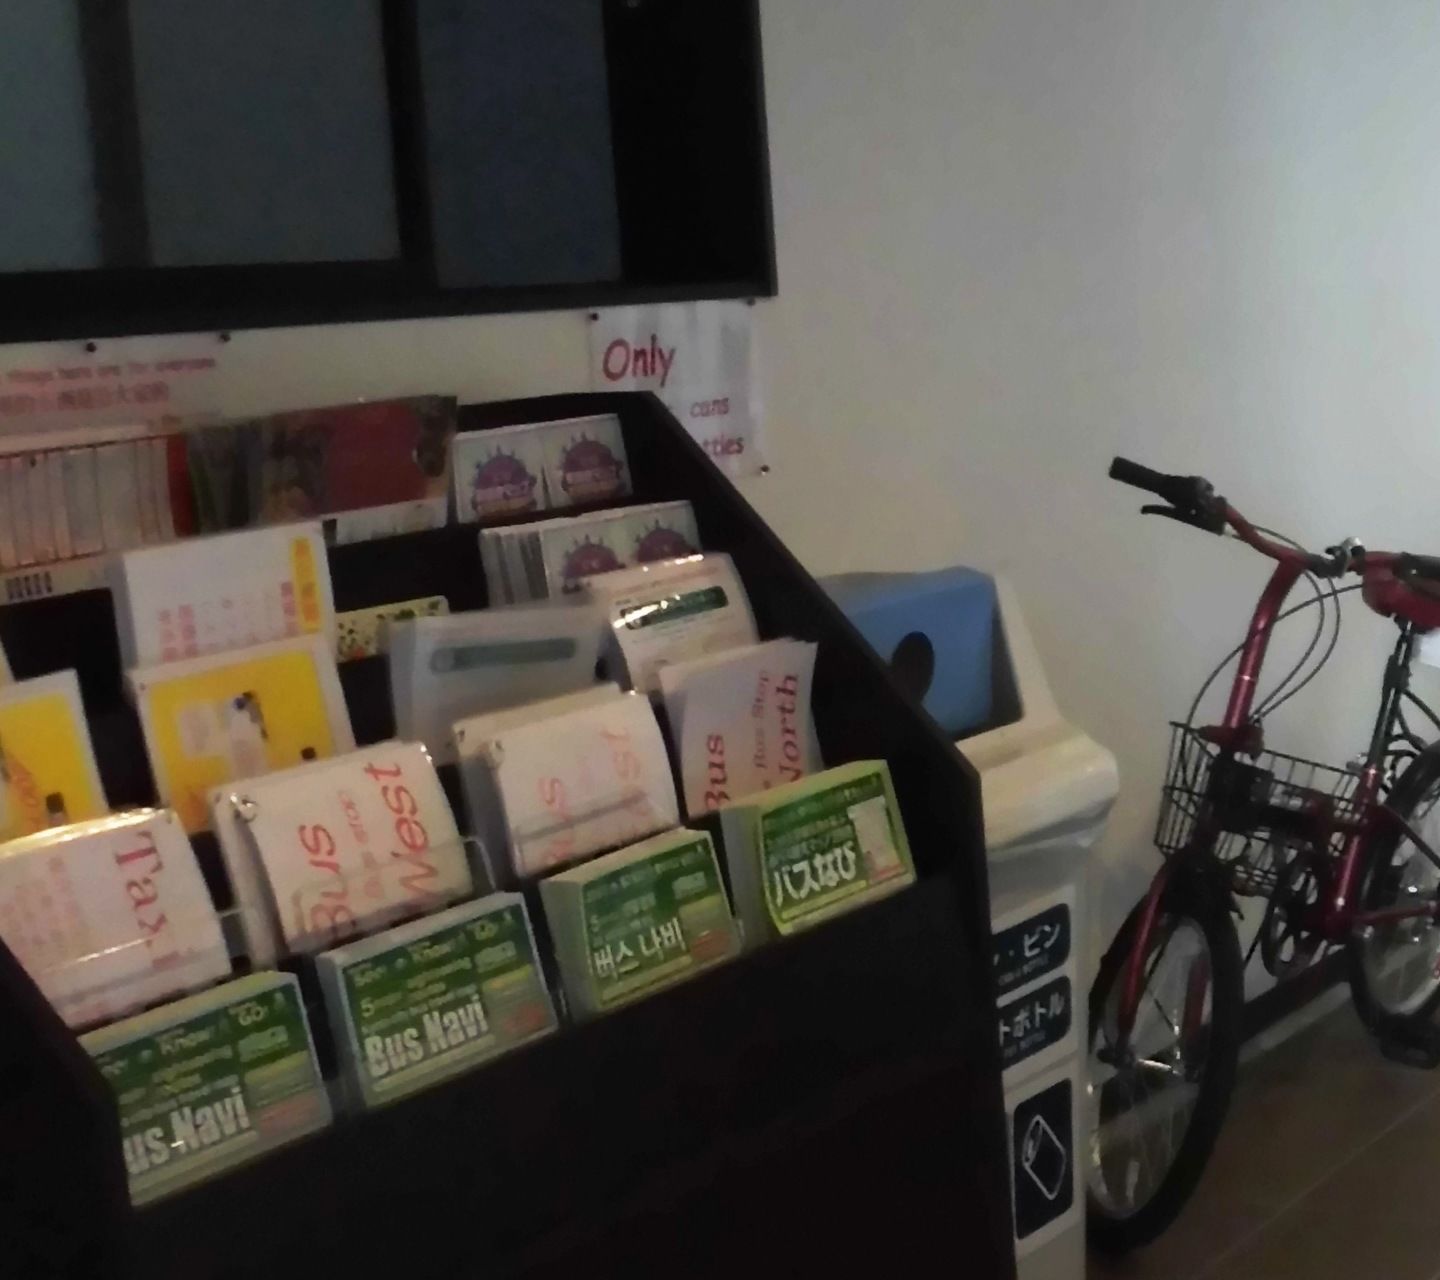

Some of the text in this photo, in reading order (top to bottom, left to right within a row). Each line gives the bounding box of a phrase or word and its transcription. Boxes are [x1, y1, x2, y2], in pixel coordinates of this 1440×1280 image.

[602, 333, 676, 389] Only
[690, 397, 730, 418] cans
[594, 916, 687, 980] 버스 나비
[364, 1027, 424, 1078] Bus
[422, 993, 489, 1054] Navi
[998, 991, 1066, 1048] トボトル
[122, 1127, 172, 1175] us
[169, 1085, 251, 1155] Navi
